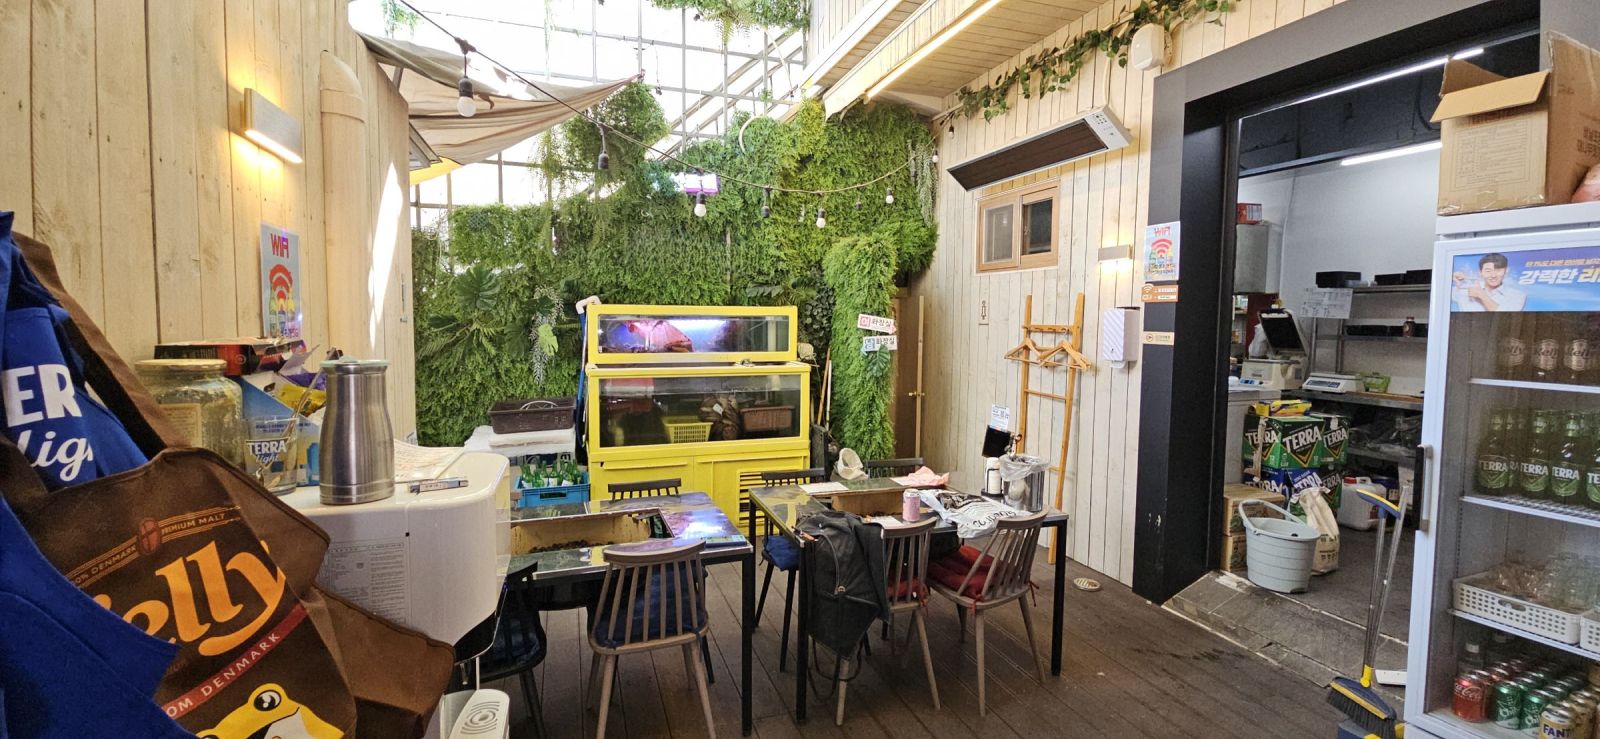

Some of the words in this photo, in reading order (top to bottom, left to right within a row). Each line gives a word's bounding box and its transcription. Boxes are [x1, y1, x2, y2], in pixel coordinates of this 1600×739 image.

[269, 232, 289, 259] WIFI
[1518, 267, 1579, 286] 강력한
[1245, 430, 1278, 446] TERA
[1283, 425, 1323, 454] TERRA
[1322, 426, 1349, 449] TERRA
[246, 440, 287, 456] TERRA
[1479, 460, 1508, 473] TERRA
[1520, 462, 1549, 476] TERRA
[1551, 465, 1580, 481] TERRA
[1321, 473, 1342, 490] ERRA
[91, 543, 137, 575] DENMARK
[198, 512, 226, 526] MALT
[93, 539, 288, 656] elly
[200, 632, 281, 698] DENMARK
